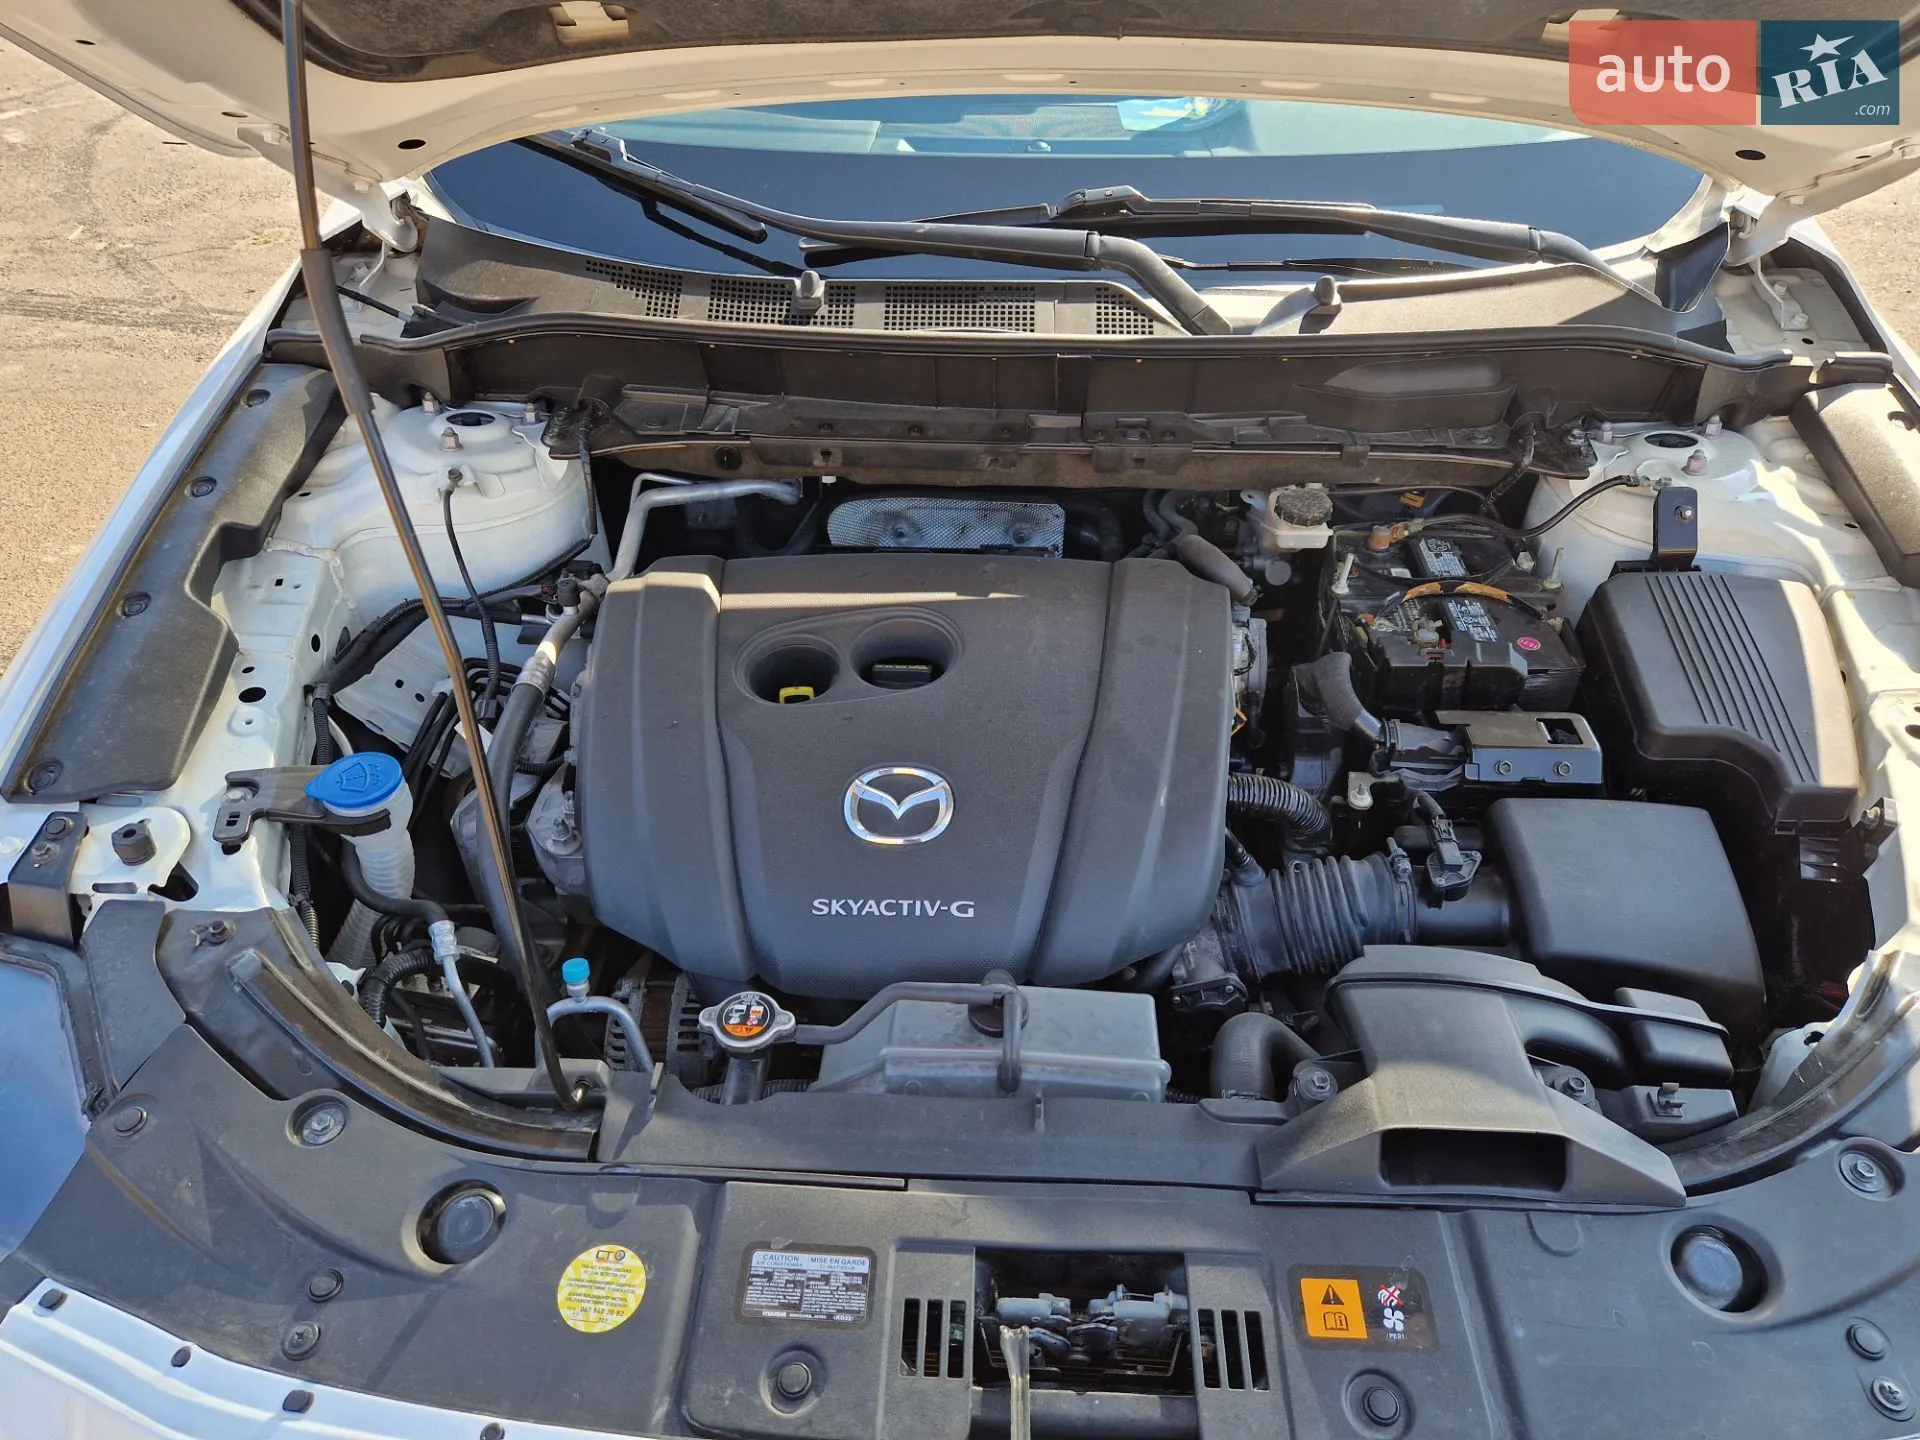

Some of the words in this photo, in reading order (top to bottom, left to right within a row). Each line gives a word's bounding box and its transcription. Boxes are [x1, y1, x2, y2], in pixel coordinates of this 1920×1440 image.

[811, 898, 975, 918] SKYACTIV-G
[762, 1254, 800, 1262] CAUTION
[810, 1256, 828, 1264] MISE
[841, 1258, 866, 1266] GARDE
